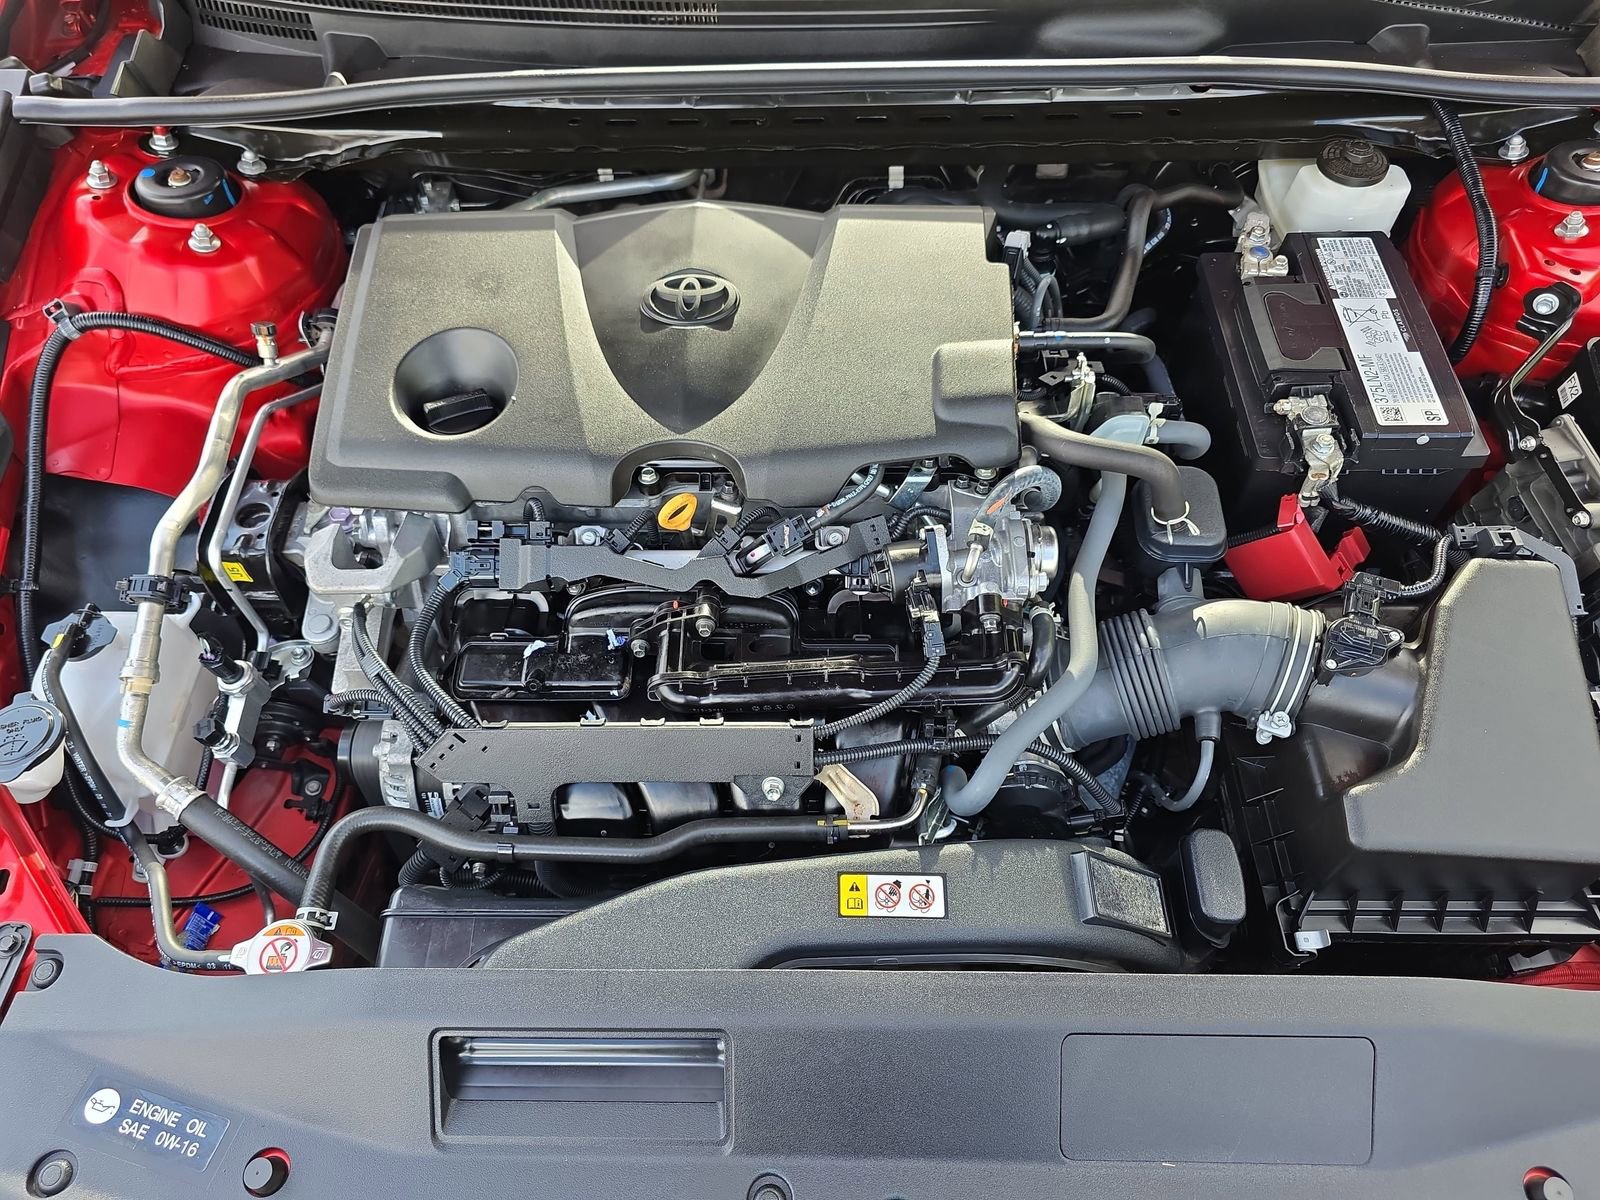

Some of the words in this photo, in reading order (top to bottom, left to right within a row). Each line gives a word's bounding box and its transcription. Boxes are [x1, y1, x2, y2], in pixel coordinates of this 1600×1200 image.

[1357, 354, 1389, 403] 375LN2-MF
[1567, 376, 1579, 398] FX2
[1424, 410, 1441, 421] SP
[73, 751, 87, 773] WATER
[129, 1098, 182, 1128] ENGINE
[186, 1118, 207, 1138] OIL
[118, 1118, 150, 1140] SAE
[154, 1131, 200, 1157] 0W-16
